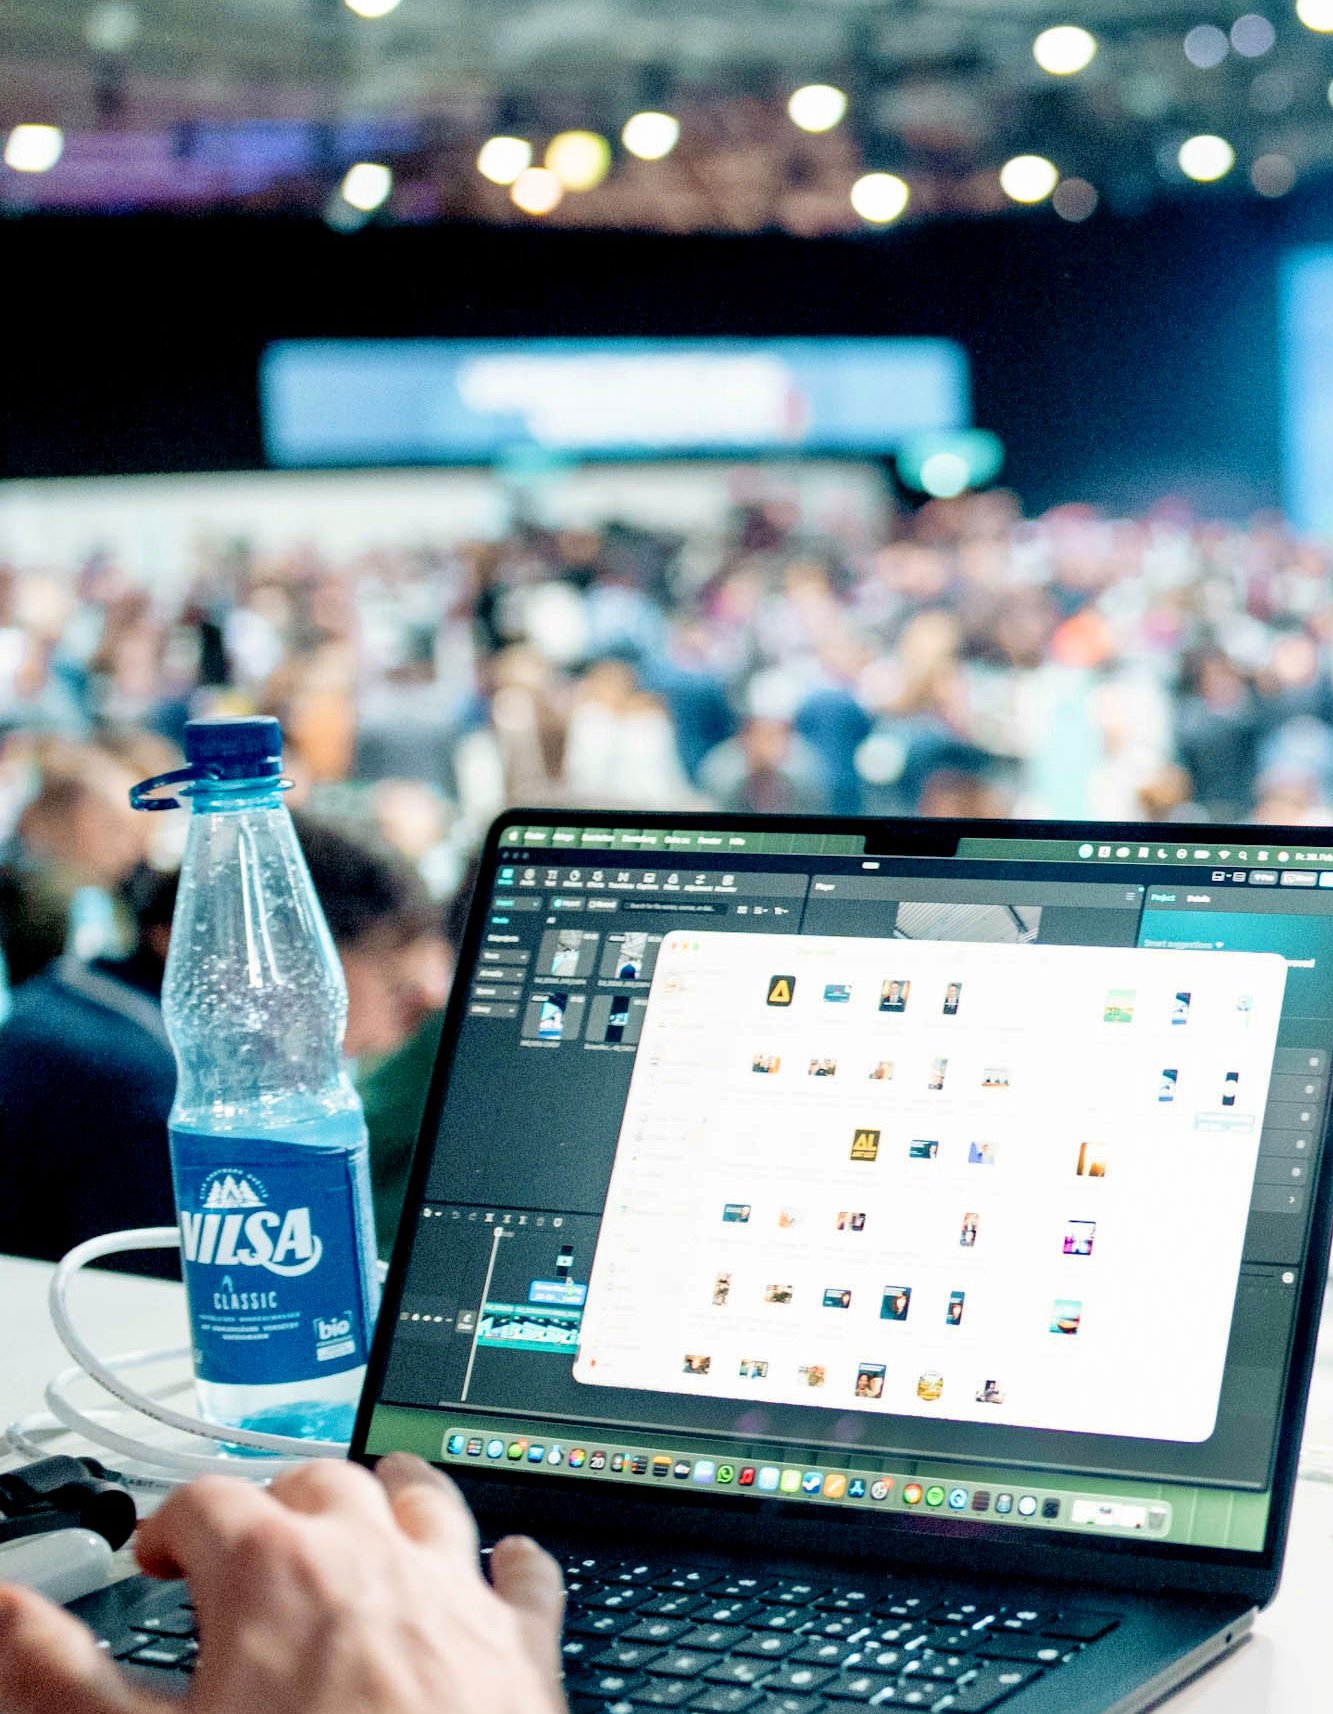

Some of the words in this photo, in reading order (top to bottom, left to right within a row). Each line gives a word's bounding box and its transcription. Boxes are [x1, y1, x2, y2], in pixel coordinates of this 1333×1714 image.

[1150, 893, 1176, 902] Project
[181, 1207, 323, 1277] VILSA
[213, 1291, 278, 1310] CLASSIC
[318, 1317, 350, 1341] bio
